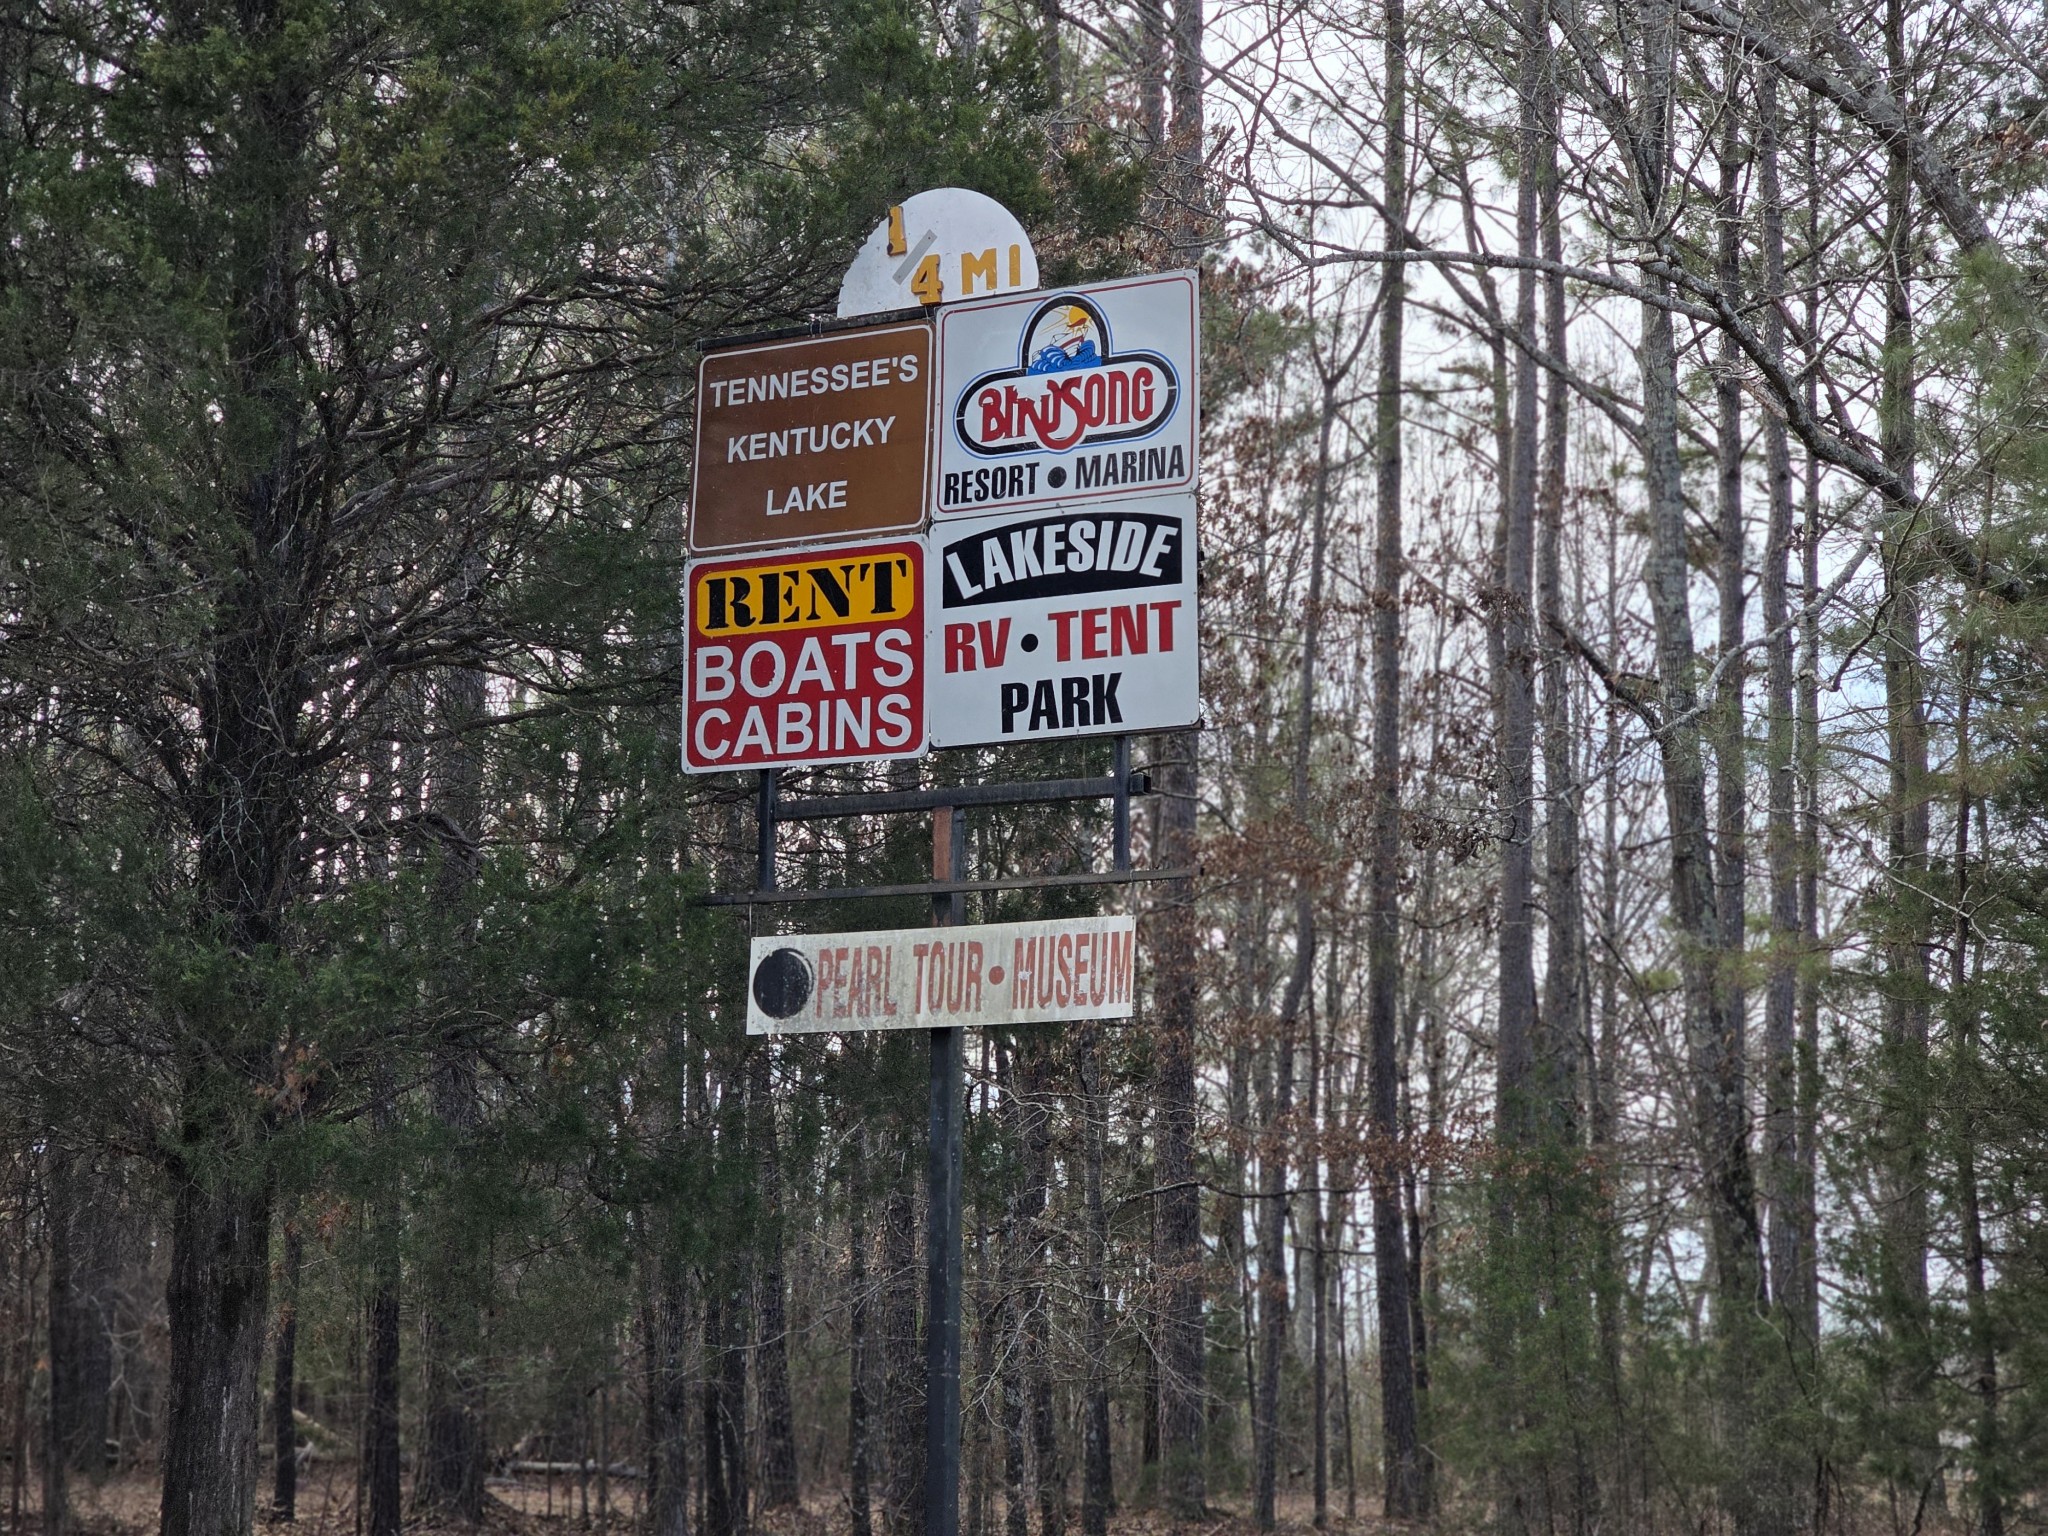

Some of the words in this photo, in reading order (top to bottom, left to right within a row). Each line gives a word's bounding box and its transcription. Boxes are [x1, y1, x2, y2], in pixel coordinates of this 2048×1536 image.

[961, 243, 1021, 295] MI
[709, 354, 918, 407] TENNESSEE'S
[727, 416, 896, 463] KENTUCKY
[766, 480, 848, 516] LAKE
[943, 462, 1040, 505] RESORT
[1075, 444, 1185, 489] MARINA
[946, 520, 1179, 600] LAKESIDE
[705, 559, 907, 629] RENT
[695, 628, 914, 702] BOATS
[944, 617, 1012, 674] RV
[1047, 600, 1182, 662] TENT
[694, 694, 912, 759] CABINS
[1001, 672, 1123, 733] PARK
[815, 945, 897, 1018] PEARL
[913, 941, 984, 1016] TOUR
[1013, 931, 1133, 1009] MUSEUM
